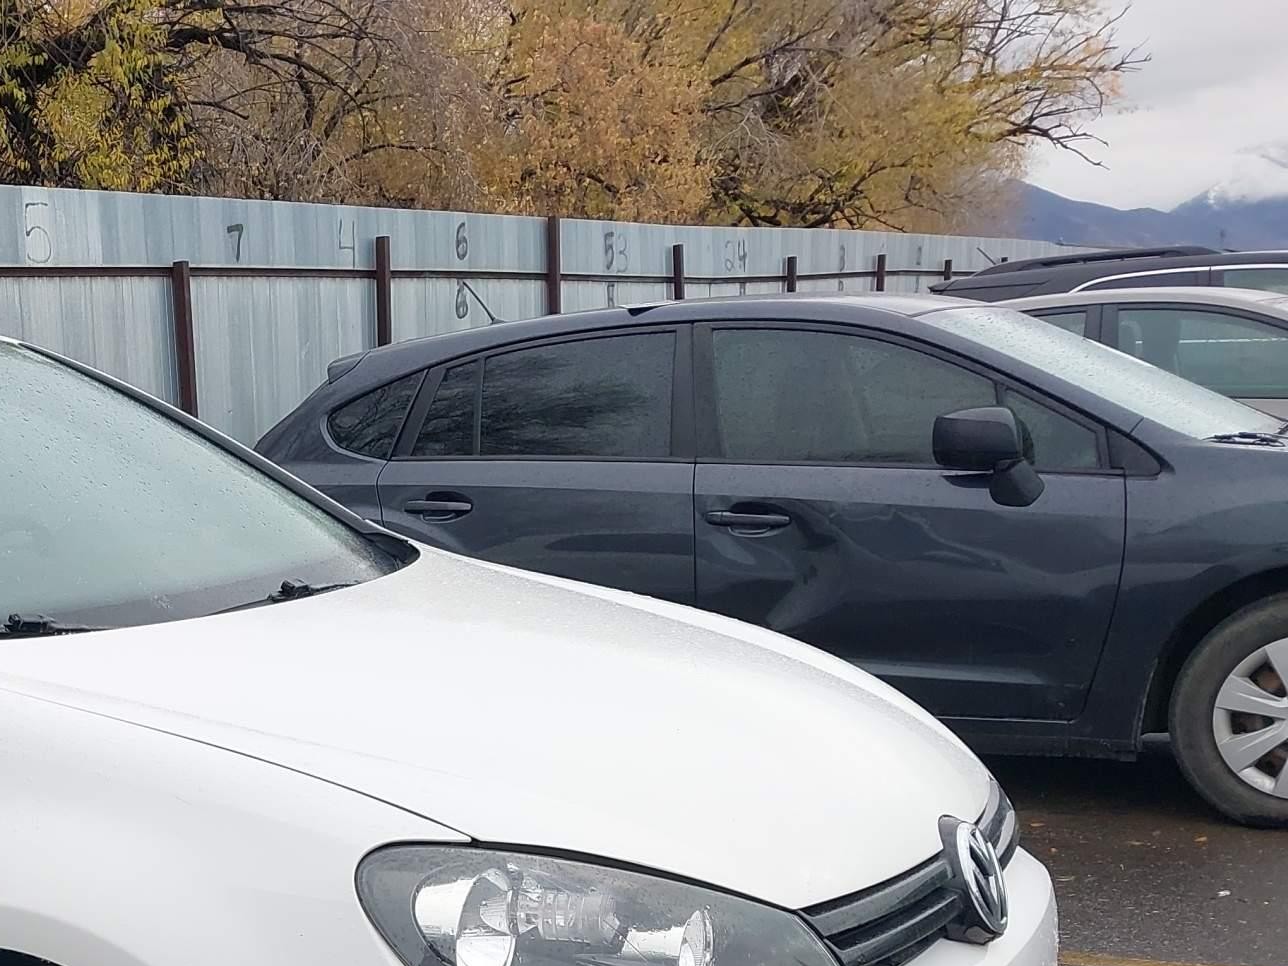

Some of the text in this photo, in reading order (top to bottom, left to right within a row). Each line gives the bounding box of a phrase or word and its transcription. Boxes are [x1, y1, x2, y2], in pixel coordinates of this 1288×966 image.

[24, 202, 52, 264] 5
[227, 223, 244, 262] 7
[338, 219, 356, 269] 4
[455, 222, 469, 261] 6
